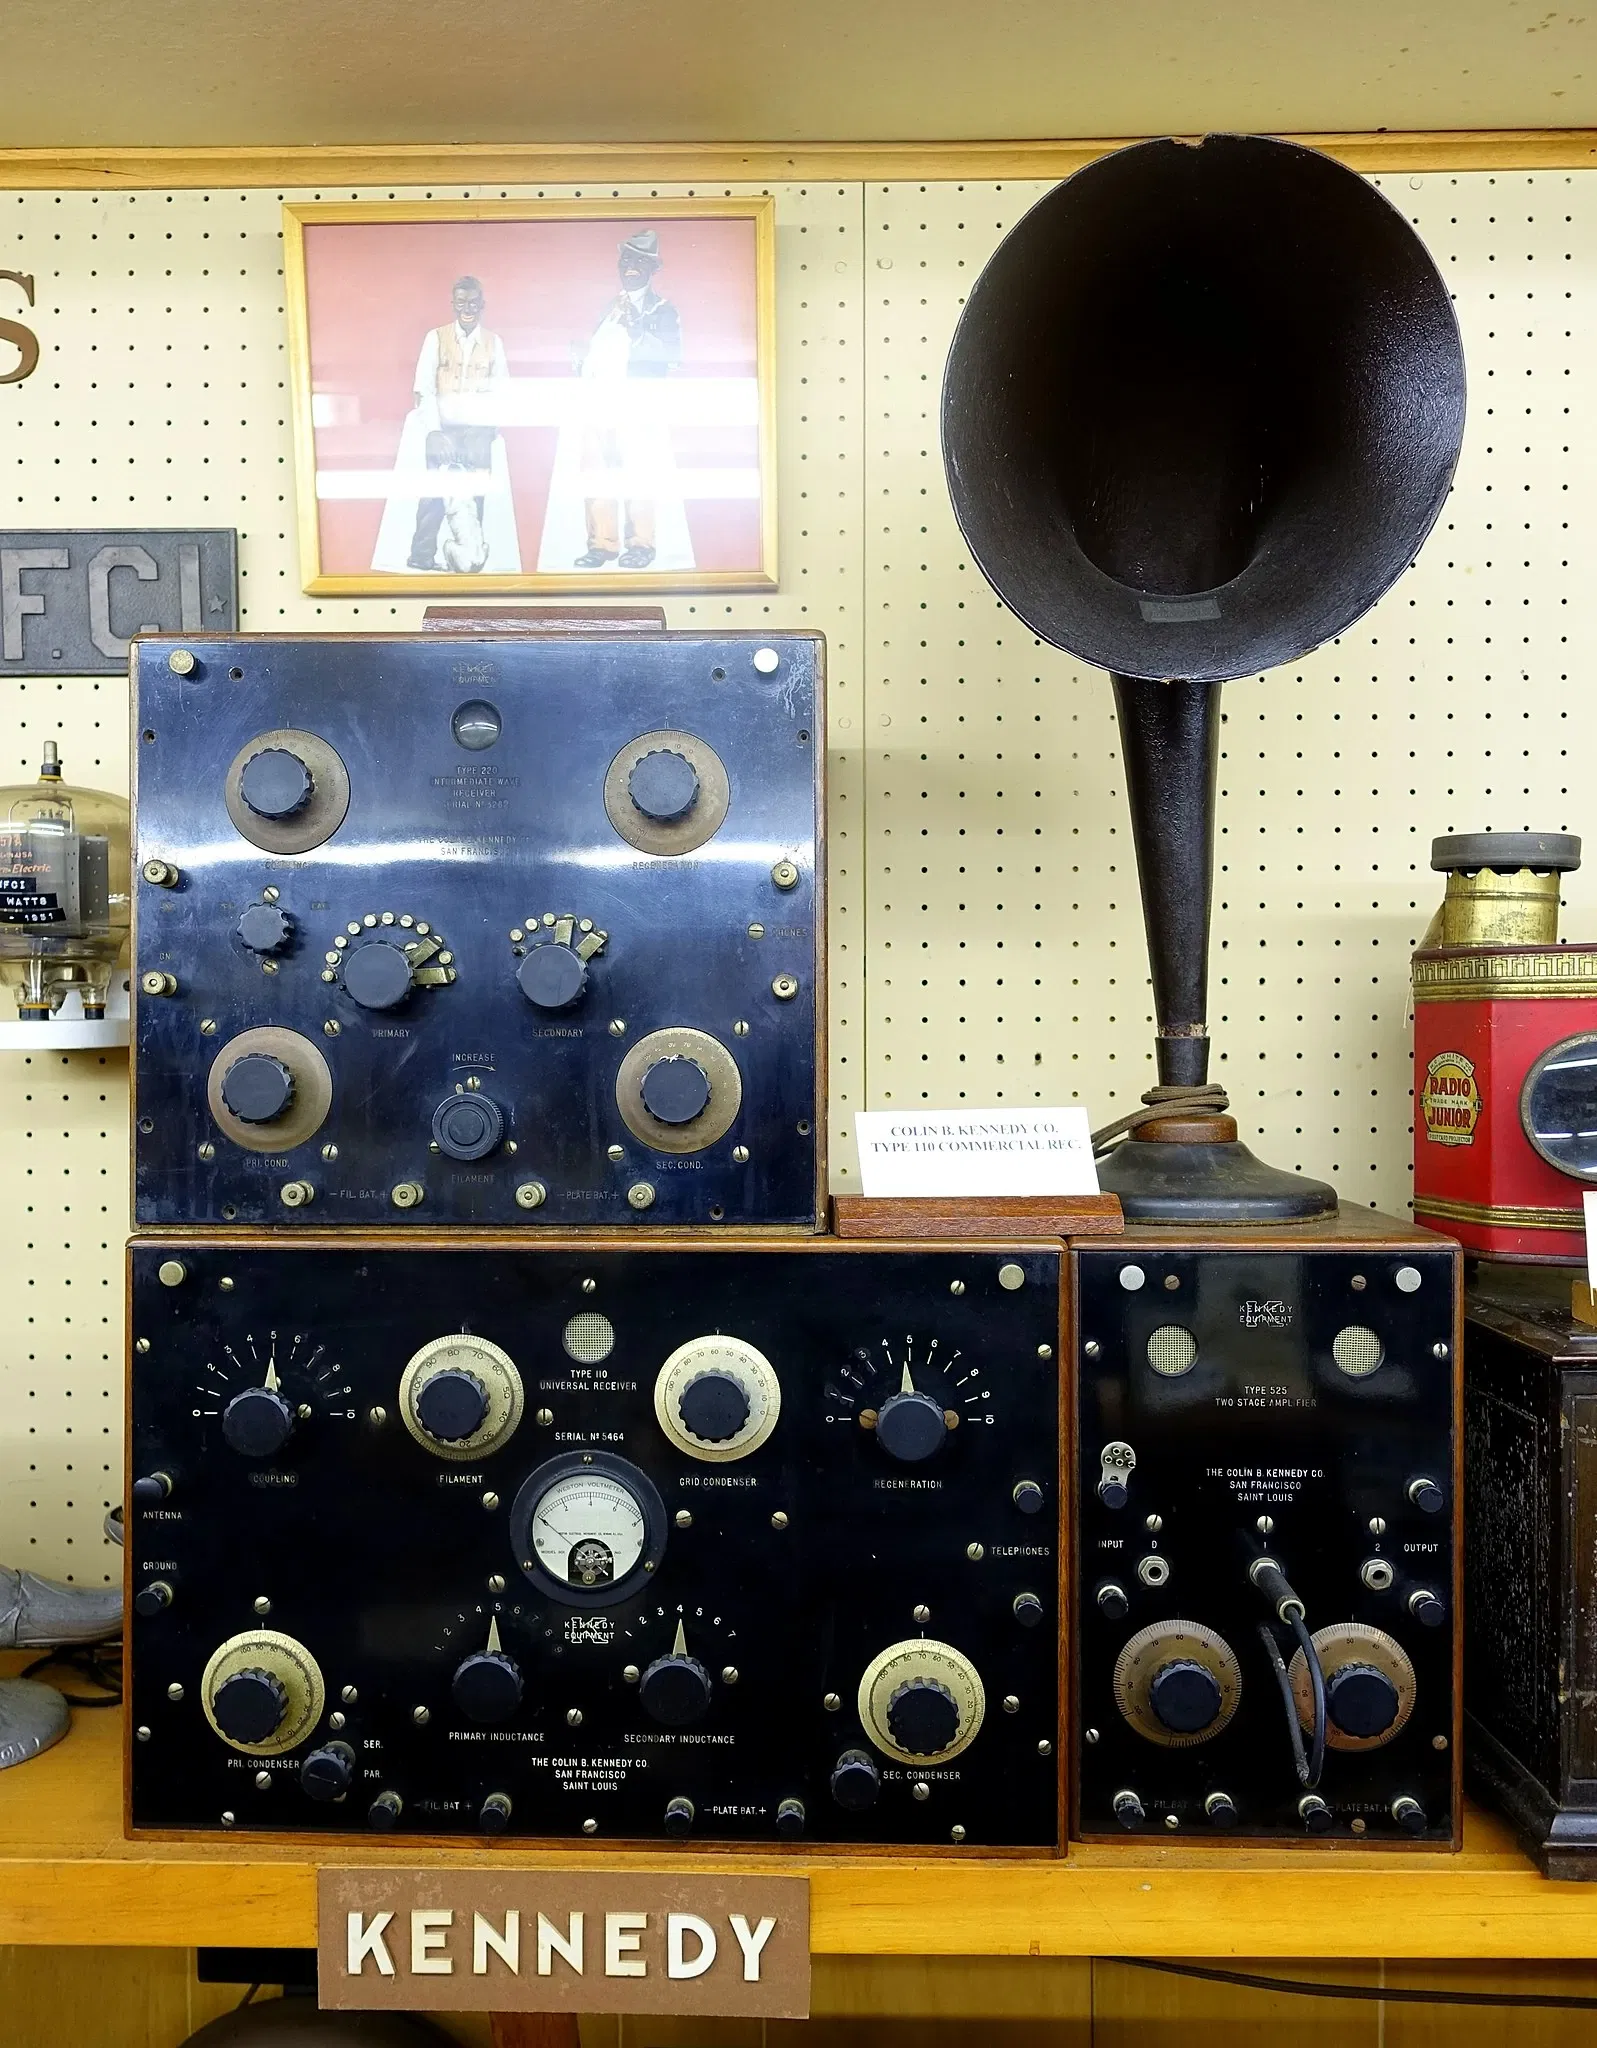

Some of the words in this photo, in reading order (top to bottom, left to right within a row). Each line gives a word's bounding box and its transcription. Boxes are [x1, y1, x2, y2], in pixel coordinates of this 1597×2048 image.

[481, 766, 498, 775] 220
[453, 789, 496, 798] RECEIVER
[441, 847, 458, 856] SAN
[12, 863, 52, 874] Electric
[6, 896, 47, 907] WATTS
[373, 1029, 411, 1038] PRIMARY
[532, 1028, 584, 1038] SECONDARY
[452, 1053, 496, 1062] INCREASE
[1430, 1077, 1471, 1097] RADIO
[1429, 1107, 1471, 1128] JUNIOR
[890, 1125, 938, 1137] COLIN
[943, 1125, 955, 1136] B.
[958, 1122, 1029, 1136] KENNEDY
[1033, 1122, 1059, 1134] CO.
[870, 1142, 911, 1153] TYPE
[915, 1141, 935, 1152] 110
[938, 1139, 1045, 1152] COMMERCIAL
[1048, 1138, 1082, 1151] REC.
[264, 1159, 290, 1168] COND.
[451, 1174, 495, 1184] FILAMENT
[1239, 1305, 1293, 1313] KENNEDY
[1239, 1315, 1293, 1323] EQUIPMENT
[246, 1334, 253, 1343] 4
[270, 1330, 277, 1340] 5
[294, 1335, 302, 1344] 6
[906, 1334, 913, 1344] 5
[881, 1338, 889, 1347] 4
[931, 1338, 938, 1348] 6
[447, 1348, 460, 1357] 80
[472, 1350, 484, 1360] 70
[953, 1349, 962, 1359] 7
[426, 1357, 437, 1368] 90
[492, 1364, 503, 1376] 60
[570, 1370, 592, 1379] TYPE
[970, 1368, 979, 1377] 8
[412, 1377, 423, 1392] 100
[540, 1381, 590, 1391] UNIVERSAL
[593, 1381, 637, 1391] RECEIVER
[502, 1386, 510, 1399] 50
[1244, 1386, 1266, 1395] TYPE
[1270, 1386, 1288, 1395] 525
[1215, 1398, 1234, 1407] TWO
[1237, 1398, 1266, 1407] STAGE
[1269, 1398, 1317, 1407] AMPLFIER
[192, 1409, 201, 1417] 0
[826, 1415, 834, 1423] 0
[555, 1432, 586, 1441] SERIAL
[602, 1432, 625, 1441] 5464
[1206, 1468, 1223, 1477] THE
[1226, 1468, 1253, 1477] COLIN
[1266, 1468, 1308, 1478] KENNEDY
[1311, 1469, 1326, 1478] CO.
[253, 1474, 296, 1484] COUPLING
[439, 1475, 483, 1484] FILAMENT
[679, 1477, 700, 1487] GRID
[703, 1477, 757, 1487] CONDENSER
[556, 1482, 584, 1494] WESTON
[587, 1481, 625, 1494] VOLTMETER
[874, 1480, 942, 1489] REGENERATION
[1229, 1480, 1247, 1489] SAN
[1251, 1480, 1302, 1490] FRANCISCO
[1237, 1493, 1264, 1502] SAINT
[1267, 1493, 1293, 1502] LOUIS
[143, 1511, 182, 1520] ANTENNA
[1098, 1539, 1124, 1549] INPUT
[1374, 1543, 1381, 1552] 2
[1403, 1543, 1439, 1553] OUTPUT
[991, 1546, 1050, 1556] TELEPHONES
[143, 1561, 177, 1571] GROUND
[475, 1605, 482, 1613] 4
[495, 1602, 501, 1611] 5
[513, 1605, 520, 1614] 6
[677, 1604, 683, 1613] 4
[657, 1607, 664, 1616] 3
[696, 1607, 703, 1616] 5
[564, 1621, 615, 1629] KENNEDY
[639, 1616, 647, 1625] 2
[713, 1616, 721, 1625] 6
[564, 1632, 615, 1640] EQUIPMENT
[449, 1732, 486, 1741] PRIMARY
[490, 1732, 545, 1742] INDUCTANCE
[624, 1734, 676, 1744] SECONDARY
[680, 1735, 735, 1744] INDUCTANCE
[363, 1740, 384, 1749] SER.
[227, 1759, 244, 1768] PRI.
[248, 1759, 300, 1769] CONDENSER
[532, 1757, 549, 1766] THE
[552, 1758, 578, 1767] COLIN
[581, 1758, 590, 1767] B.
[591, 1758, 633, 1768] KENNEDY
[364, 1769, 383, 1778] PAR.
[555, 1769, 573, 1779] SAN
[575, 1770, 626, 1779] FRANCISCO
[883, 1770, 903, 1780] SEC.
[906, 1771, 961, 1780] CONDENSER
[563, 1781, 588, 1790] SAINT
[591, 1782, 618, 1791] LOUIS
[713, 1805, 738, 1815] PLATE
[346, 1908, 777, 1982] KENNEDY
